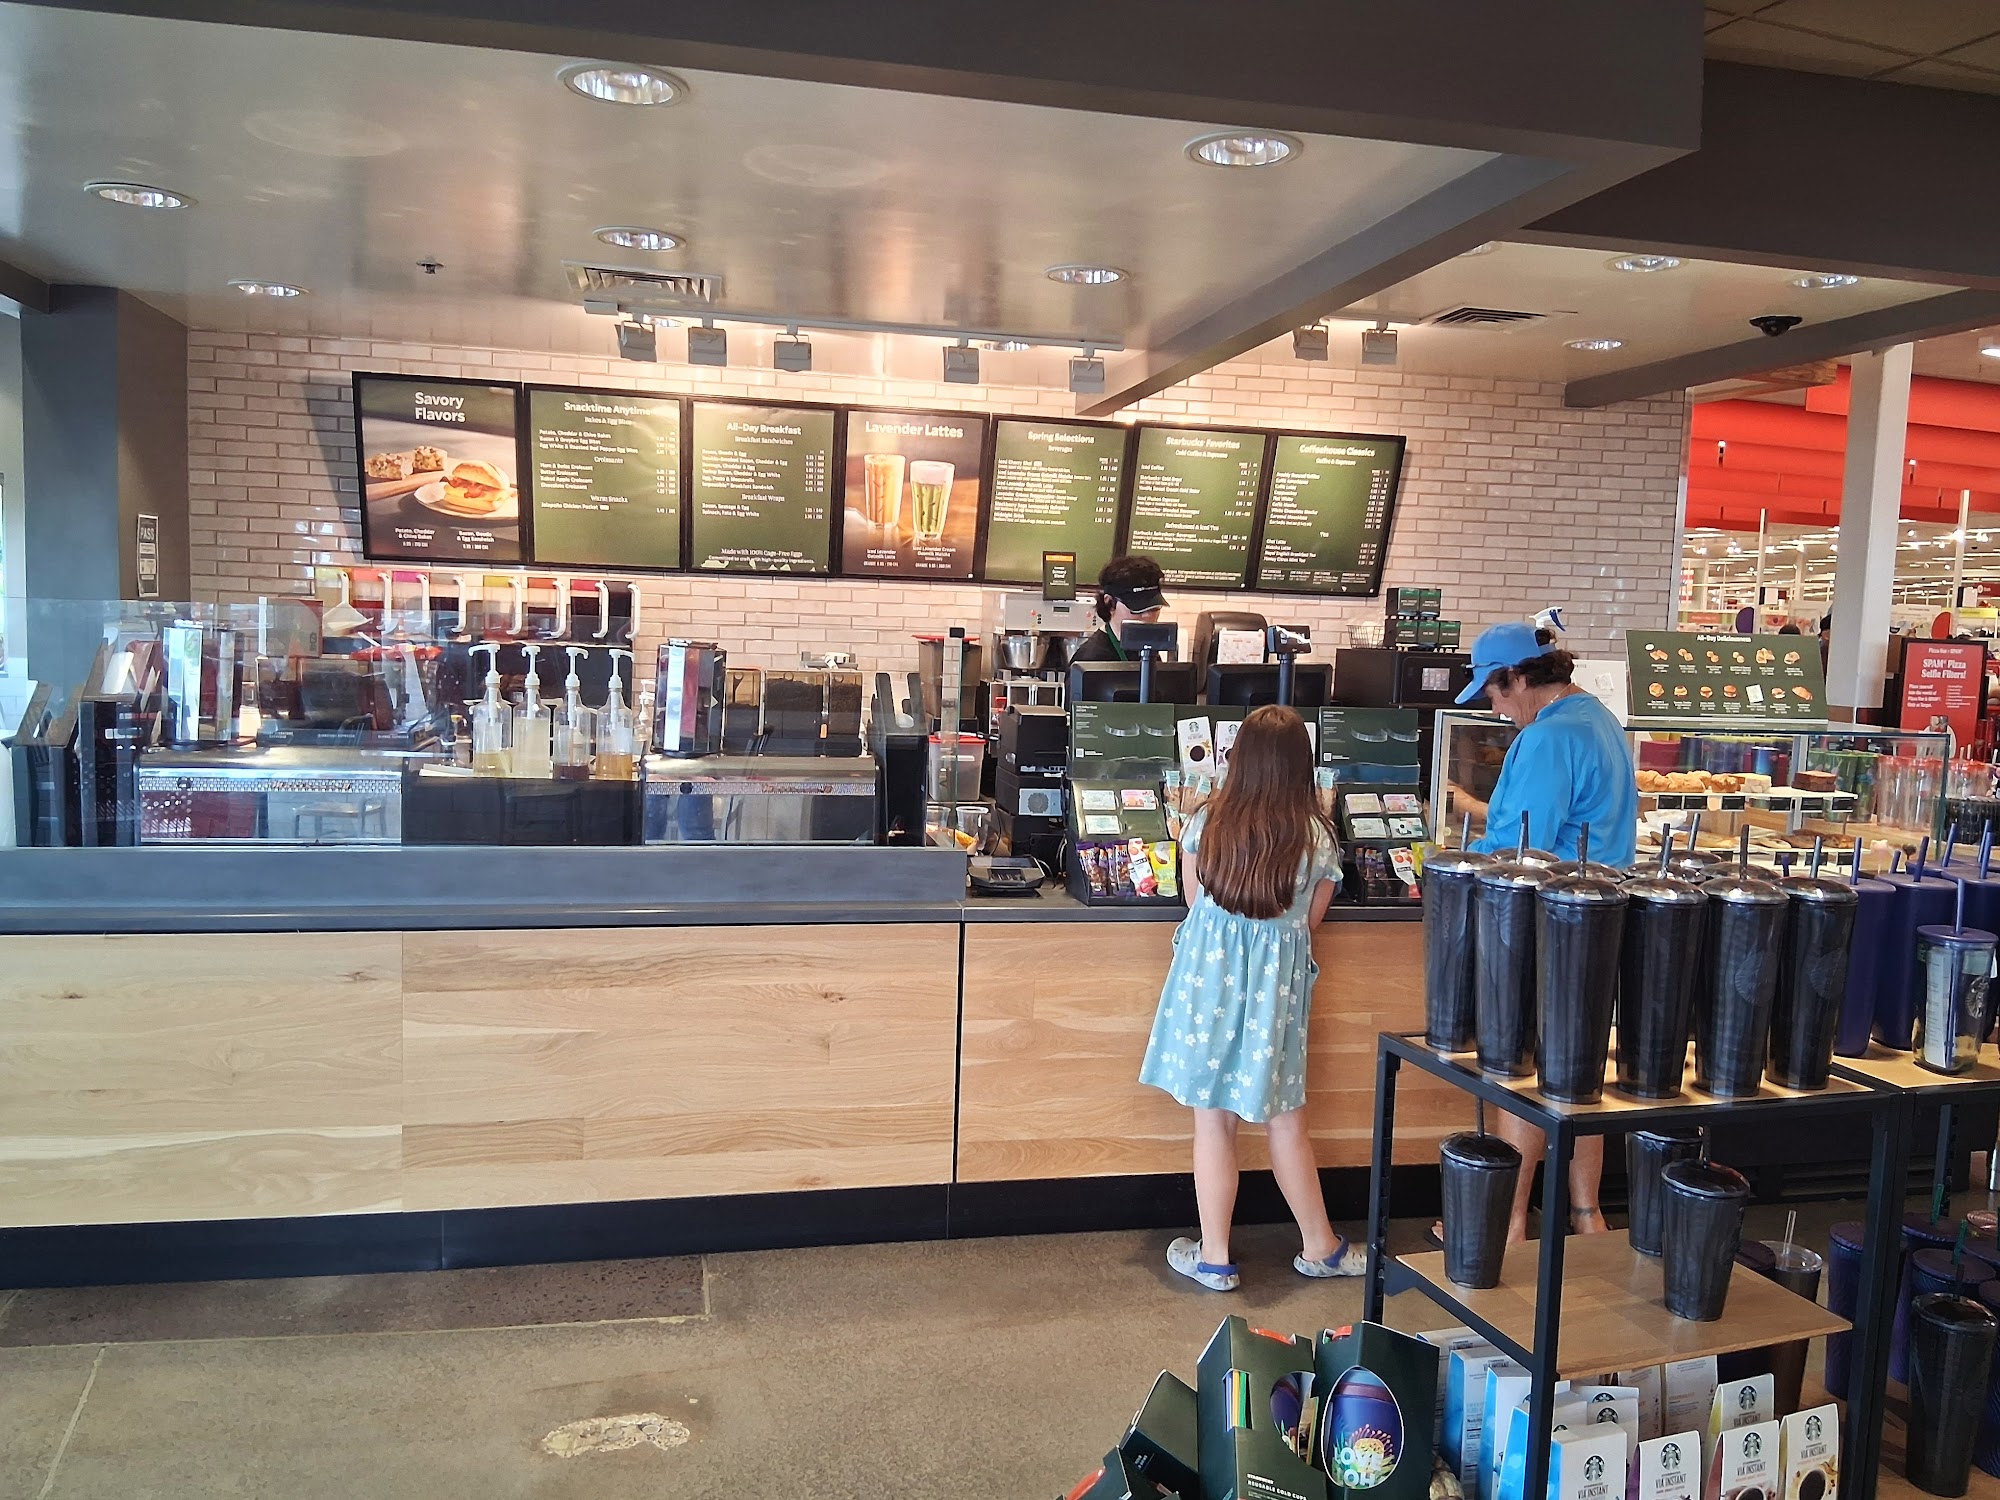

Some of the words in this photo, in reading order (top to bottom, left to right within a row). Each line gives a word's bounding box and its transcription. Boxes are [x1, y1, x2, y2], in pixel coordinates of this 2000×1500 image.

[415, 392, 464, 409] Savory
[564, 401, 612, 414] Snacktime
[415, 407, 466, 422] Flavors
[727, 422, 759, 434] All-Day
[760, 424, 801, 436] Breakfast
[865, 421, 923, 436] Lavender
[925, 423, 964, 438] Lattes
[735, 436, 760, 444] Breakfast
[761, 438, 794, 446] Sandwiches
[1028, 431, 1054, 443] Spring
[1055, 432, 1094, 444] Selections
[1205, 438, 1240, 450] Favorites
[1300, 444, 1346, 456] Coffeehouse
[1347, 447, 1376, 457] Classics
[593, 456, 624, 464] Croissants
[590, 495, 608, 503] Warm
[741, 493, 767, 501] Breakfast
[768, 494, 785, 503] Wraps
[140, 527, 154, 541] PASS
[791, 550, 802, 558] Eggs
[1697, 634, 1716, 643] All-Day
[1717, 635, 1752, 643] Deliciousness
[1947, 660, 1966, 669] Pizza
[1921, 669, 1941, 678] Selfie
[1942, 670, 1966, 679] Filters!
[1800, 1450, 1808, 1459] VIA
[1808, 1444, 1827, 1458] INSTANT
[1334, 1446, 1382, 1471] LOVE
[1737, 1466, 1746, 1476] VIA
[1745, 1462, 1766, 1474] INSTANT
[1655, 1479, 1665, 1489] VIA
[1665, 1473, 1686, 1487] INSTANT
[1247, 1480, 1276, 1493] REUSABLE
[1276, 1488, 1292, 1497] COLD
[1292, 1492, 1307, 1500] CUPS
[1578, 1489, 1587, 1499] VIA
[1587, 1485, 1608, 1498] INSTANT
